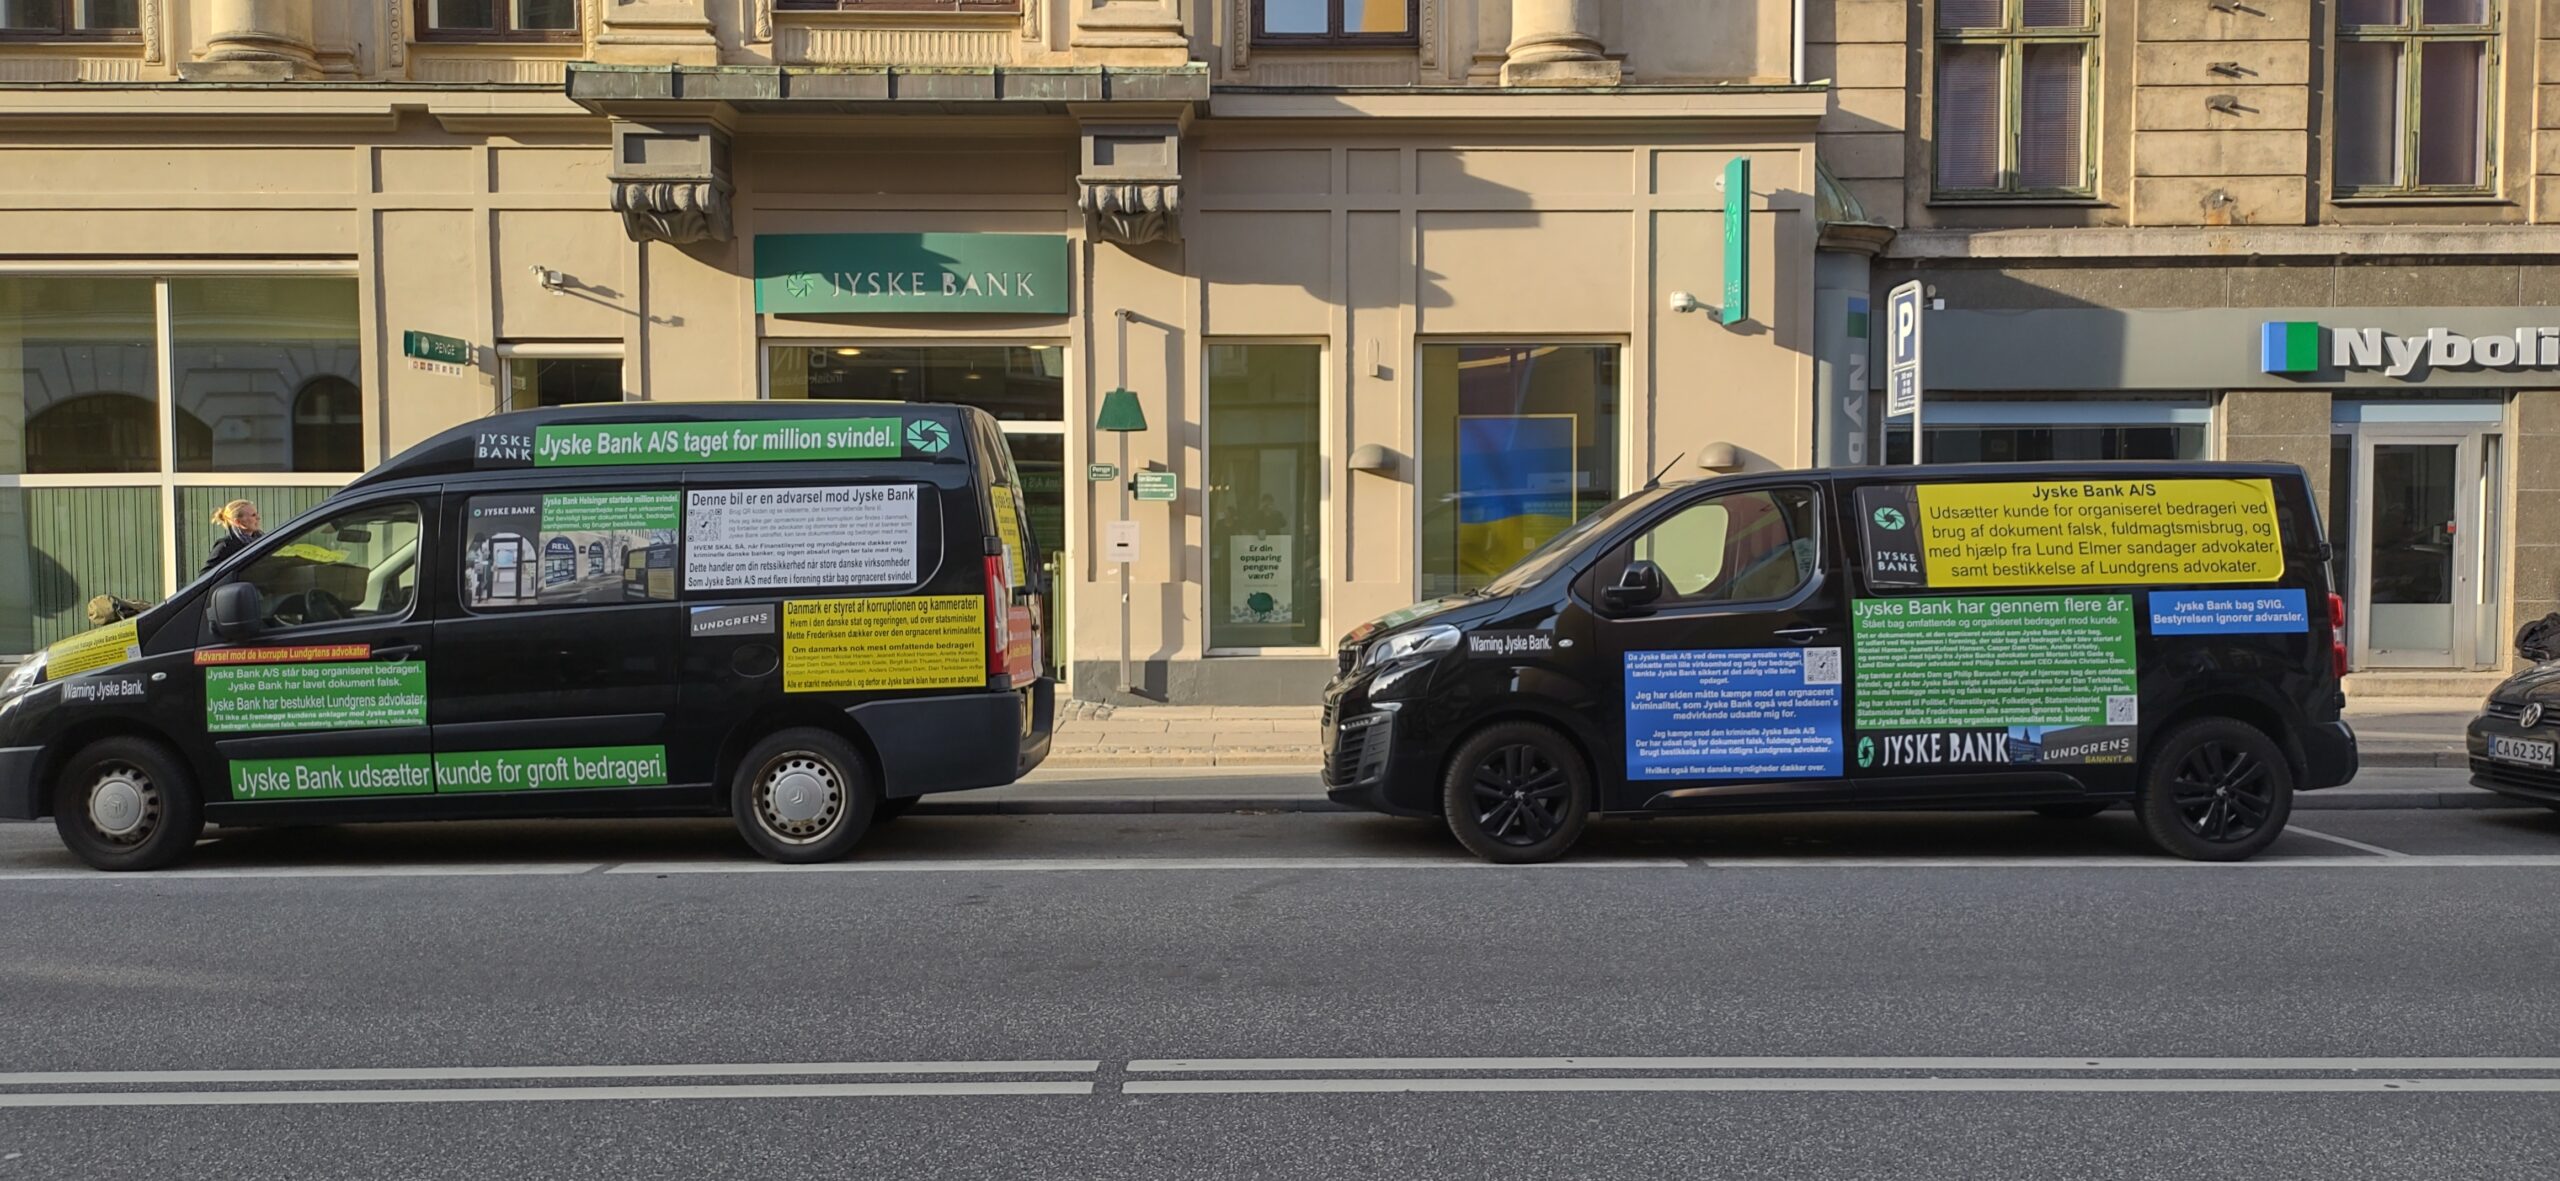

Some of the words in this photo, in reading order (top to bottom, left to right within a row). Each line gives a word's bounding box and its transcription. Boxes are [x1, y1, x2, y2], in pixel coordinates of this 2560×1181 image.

[831, 272, 925, 297] JYSKE
[942, 272, 1035, 298] BANK
[1898, 301, 1914, 357] P
[435, 342, 456, 356] PENGE
[479, 433, 531, 448] JYSKE
[540, 432, 594, 461] Jyske
[597, 431, 644, 454] Bank
[647, 431, 681, 453] A/S
[684, 429, 730, 457] taget
[733, 429, 759, 451] for
[763, 427, 820, 450] million
[824, 426, 895, 449] svindel.
[478, 447, 532, 461] BANK
[692, 493, 727, 506] Denne
[729, 492, 743, 505] bil
[744, 495, 758, 504] er
[759, 494, 773, 504] en
[775, 490, 822, 504] advarsel
[823, 490, 849, 503] mod
[851, 489, 884, 505] Jyske
[885, 488, 915, 501] Bank
[2032, 485, 2081, 501] Jyske
[2083, 484, 2127, 497] Bank
[2129, 483, 2156, 496] A/S
[484, 507, 509, 516] JYSKE
[510, 505, 536, 515] BANK
[1930, 505, 2001, 519] Udsætter
[2004, 504, 2050, 518] kunde
[2053, 504, 2075, 517] for
[2078, 502, 2164, 520] organiseret
[2167, 501, 2236, 518] bedrageri
[2238, 501, 2268, 514] ved
[1932, 525, 1965, 542] brug
[1967, 525, 1983, 538] af
[1985, 524, 2063, 538] dokument
[2065, 523, 2108, 539] falsk,
[2110, 521, 2250, 539] fuldmagtsmisbrug,
[2252, 524, 2271, 537] og
[1259, 544, 1273, 552] din
[1877, 551, 1917, 562] JYSKE
[1929, 544, 1963, 558] med
[1966, 544, 2009, 560] hjælp
[2011, 543, 2034, 556] fra
[2036, 543, 2076, 556] Lund
[2078, 542, 2124, 555] Elmer
[2127, 541, 2199, 558] sandager
[2201, 540, 2279, 556] advokater,
[1240, 554, 1282, 562] opsparing
[1878, 561, 1919, 573] BANK
[1243, 564, 1279, 572] pengene
[1248, 572, 1275, 580] værd?
[1951, 564, 1990, 577] samt
[1993, 562, 2075, 577] bestikkelse
[2078, 562, 2093, 575] af
[2096, 561, 2179, 578] Lundgrens
[2181, 559, 2261, 573] advokater.
[788, 601, 822, 615] Danmark
[823, 604, 832, 614] er
[832, 601, 855, 616] styret
[856, 600, 865, 613] af
[865, 599, 916, 616] korruptionen
[917, 601, 928, 614] og
[929, 597, 978, 611] kammerateri
[1854, 601, 1906, 618] Jyske
[1909, 600, 1954, 614] Bank
[1958, 600, 1987, 614] har
[1990, 602, 2058, 617] gennem
[2061, 598, 2101, 612] flere
[2104, 597, 2129, 612] år.
[2174, 601, 2204, 612] Jyske
[2205, 601, 2233, 610] Bank
[2234, 601, 2254, 611] bag
[2255, 600, 2285, 609] SVIG.
[693, 613, 767, 632] LUNDGRENS
[1862, 619, 1885, 628] Stået
[1886, 619, 1904, 629] bag
[1906, 618, 1956, 627] omfattende
[1957, 620, 1970, 628] og
[1971, 617, 2022, 628] organiseret
[2023, 617, 2066, 628] bedrageri
[2067, 616, 2088, 625] mod
[2089, 616, 2120, 625] kunde.
[2154, 614, 2214, 625] Bestyrelsen
[2254, 613, 2305, 622] advarsler.
[1504, 636, 1527, 654] Jyske
[1528, 636, 1552, 650] Bank.
[208, 669, 234, 681] Jyske
[235, 669, 260, 678] Bank
[261, 668, 279, 677] A/S
[280, 667, 299, 677] står
[300, 667, 319, 679] bag
[320, 666, 373, 678] organiseret
[374, 664, 422, 677] bedrageri.
[96, 682, 119, 700] Jyske
[120, 681, 144, 695] Bank.
[228, 681, 255, 693] Jyske
[256, 680, 283, 690] Bank
[284, 680, 301, 689] har
[302, 679, 326, 689] lavet
[327, 678, 375, 688] dokument
[376, 677, 402, 687] falsk.
[208, 698, 235, 714] Jyske
[236, 697, 261, 710] Bank
[262, 697, 278, 709] har
[279, 695, 325, 709] bestukket
[326, 694, 376, 711] Lundgrens
[377, 692, 426, 706] advokater.
[1635, 691, 1651, 701] Jeg
[1652, 691, 1667, 699] har
[1668, 691, 1693, 699] siden
[1694, 690, 1719, 698] måtte
[1720, 690, 1752, 700] kæmpe
[1753, 689, 1773, 697] mod
[1883, 733, 1942, 767] JYSKE
[1949, 732, 2010, 763] BANK
[2043, 738, 2130, 761] LUNDGRENS
[2496, 740, 2510, 756] CA
[2513, 742, 2527, 758] 62
[2529, 744, 2552, 762] 354
[238, 767, 290, 798] Jyske
[296, 765, 344, 790] Bank
[348, 762, 430, 788] udsætter
[434, 760, 492, 785] kunde
[496, 759, 520, 783] for
[526, 757, 570, 788] groft
[574, 754, 666, 786] bedrageri.
